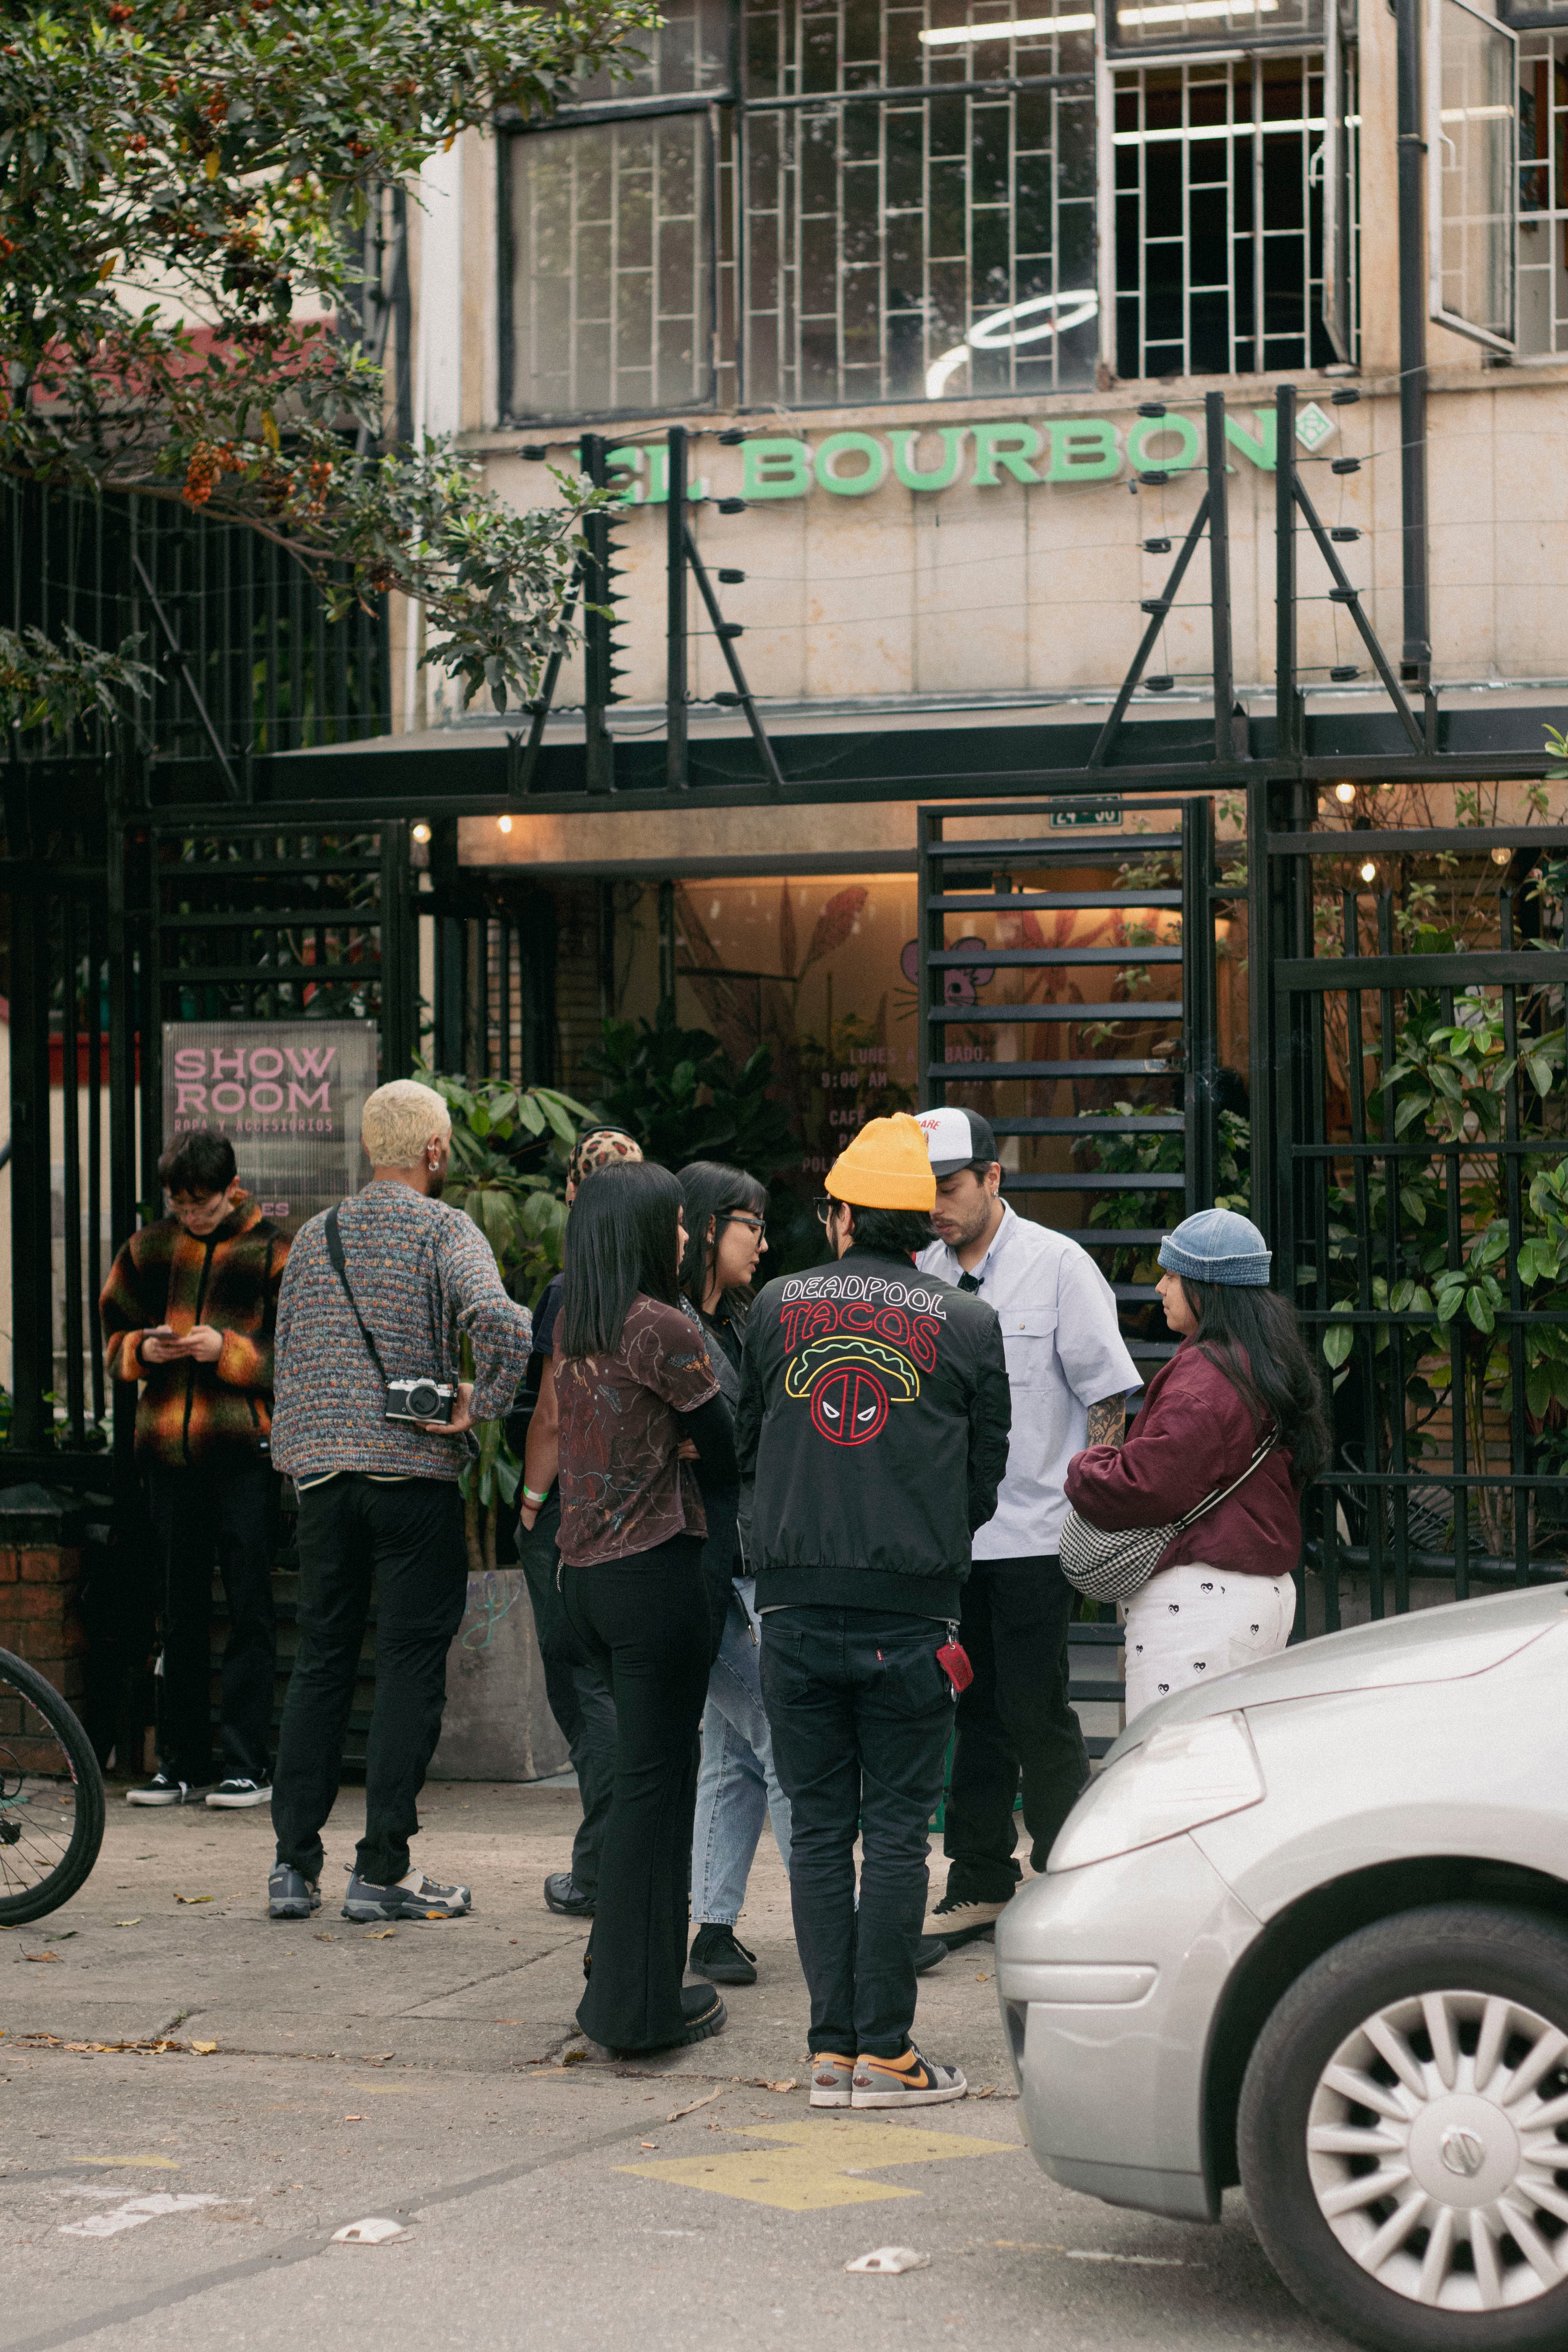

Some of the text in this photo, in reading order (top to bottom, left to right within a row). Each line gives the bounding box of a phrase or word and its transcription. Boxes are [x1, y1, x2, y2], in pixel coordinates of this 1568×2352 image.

[738, 408, 1278, 500] BOURBON
[174, 1047, 336, 1079] SHOW
[850, 1047, 896, 1064] LUNES
[944, 1046, 991, 1062] BADO.
[822, 1072, 858, 1088] 9:00
[869, 1072, 887, 1087] AM
[174, 1082, 332, 1114] ROOM
[174, 1119, 207, 1131] ROPA
[218, 1119, 226, 1131] Y
[918, 1119, 941, 1130] ARE
[782, 1276, 947, 1320] DEADPOOL
[780, 1300, 940, 1373] TACOS
